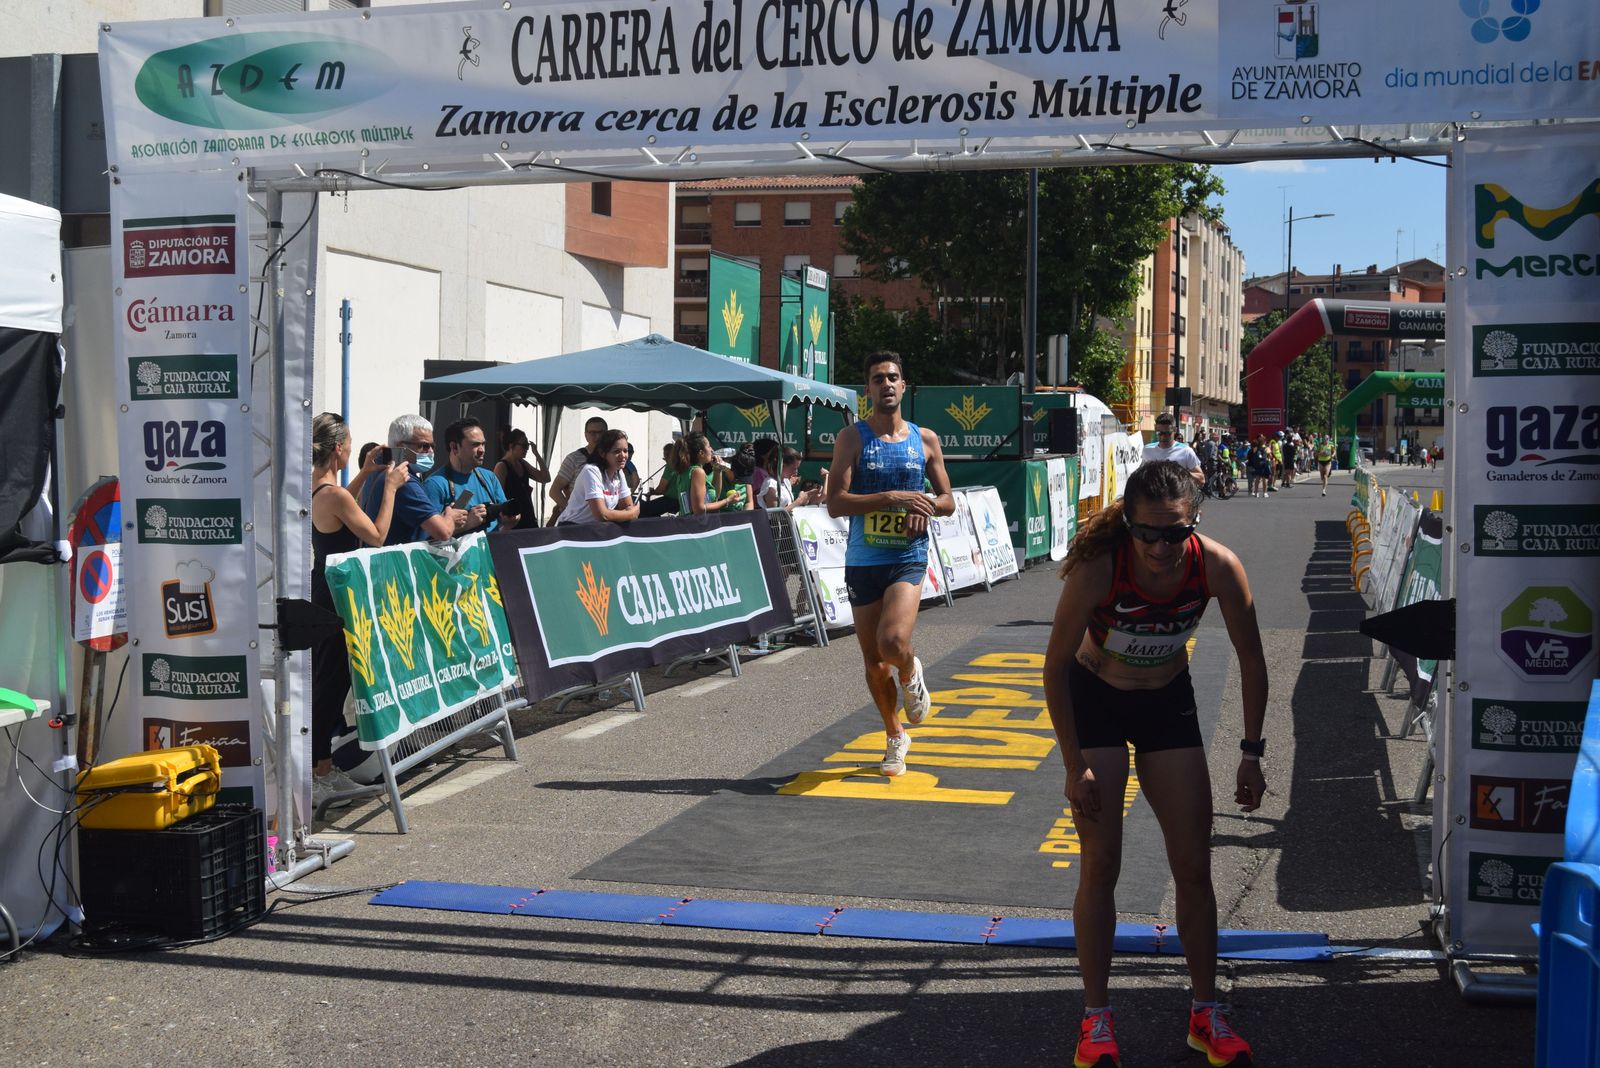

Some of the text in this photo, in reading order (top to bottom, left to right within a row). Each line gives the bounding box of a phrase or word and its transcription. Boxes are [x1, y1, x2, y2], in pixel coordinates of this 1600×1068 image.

[511, 0, 1121, 86] CARRERA del CERCO de ZAMORA
[1232, 62, 1362, 81] AYUNTAMIENTO
[1385, 67, 1418, 88] dia
[1424, 62, 1514, 86] mundial
[1520, 61, 1549, 83] de
[1553, 60, 1573, 81] la
[1231, 79, 1361, 100] DE ZAMORA
[435, 74, 1203, 137] Zamora cerca de la Esclerosis Múltiple
[131, 125, 414, 158] ASOCIACIÓN ZAMORANA DE ESCLEROSIS MÚLTIPLE
[148, 234, 229, 249] DIPUTACIÓN DE
[148, 248, 230, 267] ZAMORA
[1399, 309, 1422, 318] CON
[1424, 310, 1437, 319] EL
[164, 330, 197, 340] Zamora
[1522, 356, 1561, 370] CAJA
[163, 371, 232, 383] FUNDACION
[163, 383, 231, 395] CAJA RURAL
[717, 431, 748, 443] CAJA
[964, 435, 1012, 447] RURAL
[143, 420, 227, 472] gaza
[146, 474, 227, 484] Ganaderos de Zamora
[1486, 469, 1600, 482] Ganaderos de Zamo
[168, 517, 234, 528] FUNDACION
[168, 528, 235, 540] CAJA RURAL
[1522, 538, 1561, 551] CAJA
[616, 562, 742, 626] CAJA RURAL
[166, 594, 209, 624] Susi
[1124, 643, 1174, 656] MARTA
[171, 671, 240, 684] FUNDACION
[171, 683, 240, 695] CAJA RURAL
[1520, 735, 1558, 748] CAJA
[1531, 785, 1569, 826] Fa
